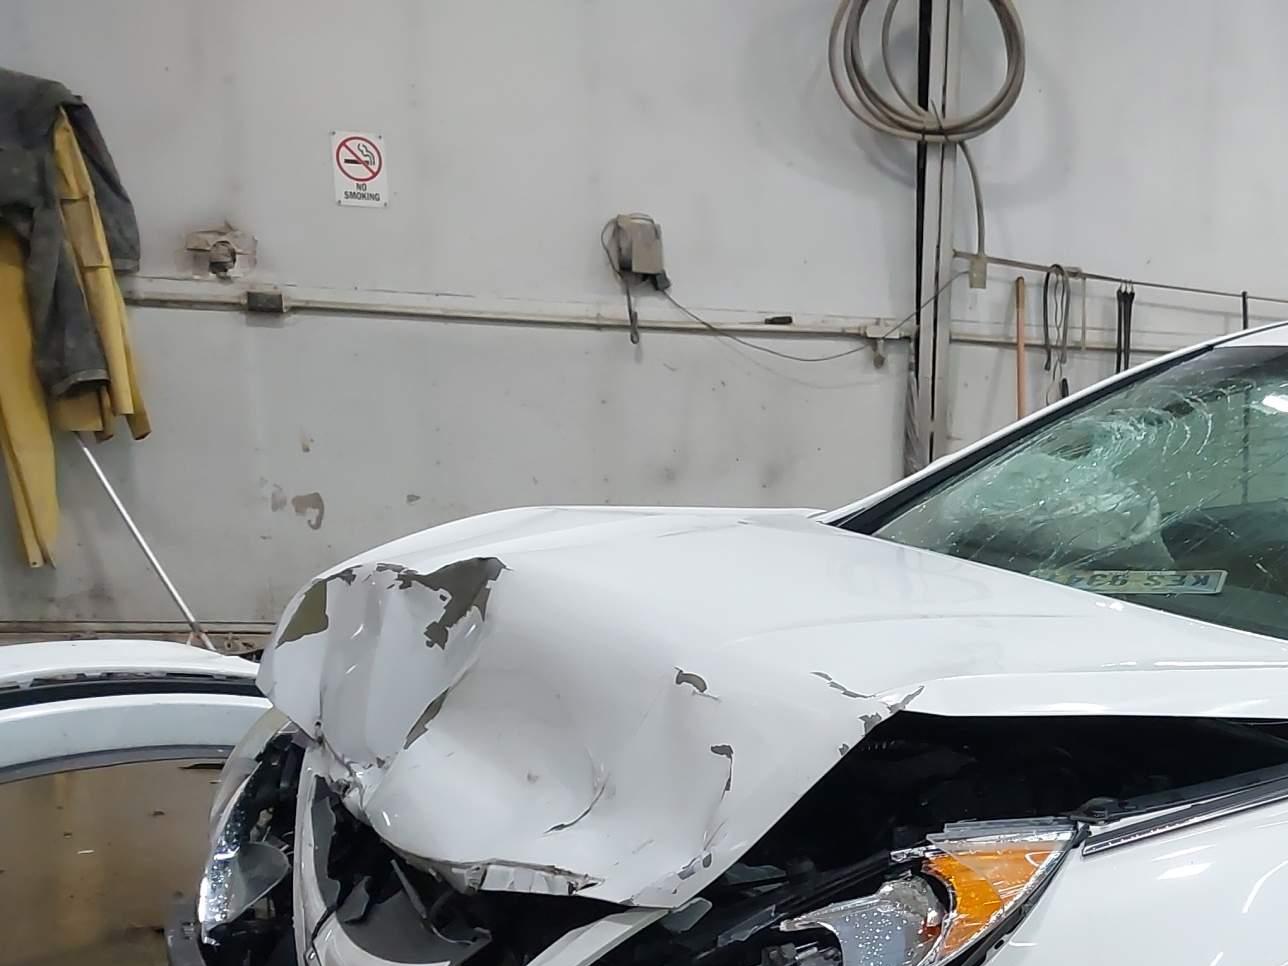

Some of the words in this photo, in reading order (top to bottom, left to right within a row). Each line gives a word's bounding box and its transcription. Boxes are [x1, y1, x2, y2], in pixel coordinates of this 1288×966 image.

[356, 183, 366, 191] NO
[344, 191, 380, 201] SMOKING
[1143, 574, 1210, 587] KES
